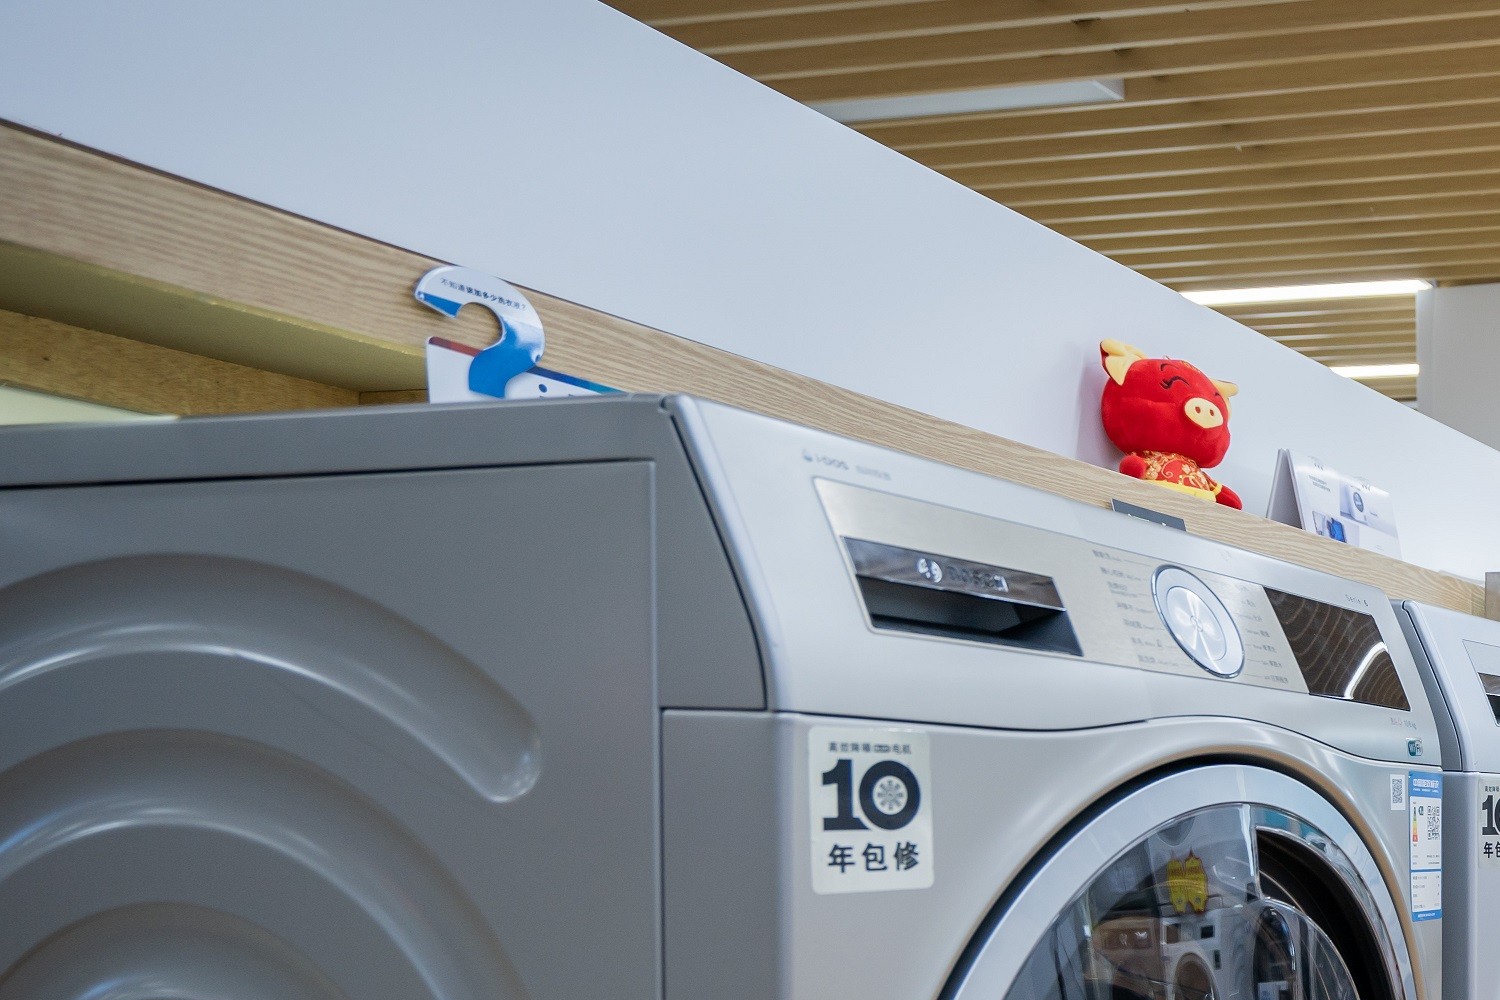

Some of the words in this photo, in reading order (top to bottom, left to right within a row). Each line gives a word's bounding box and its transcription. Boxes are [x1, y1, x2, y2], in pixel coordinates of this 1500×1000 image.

[821, 758, 921, 831] 10
[827, 840, 919, 873] 年包修
